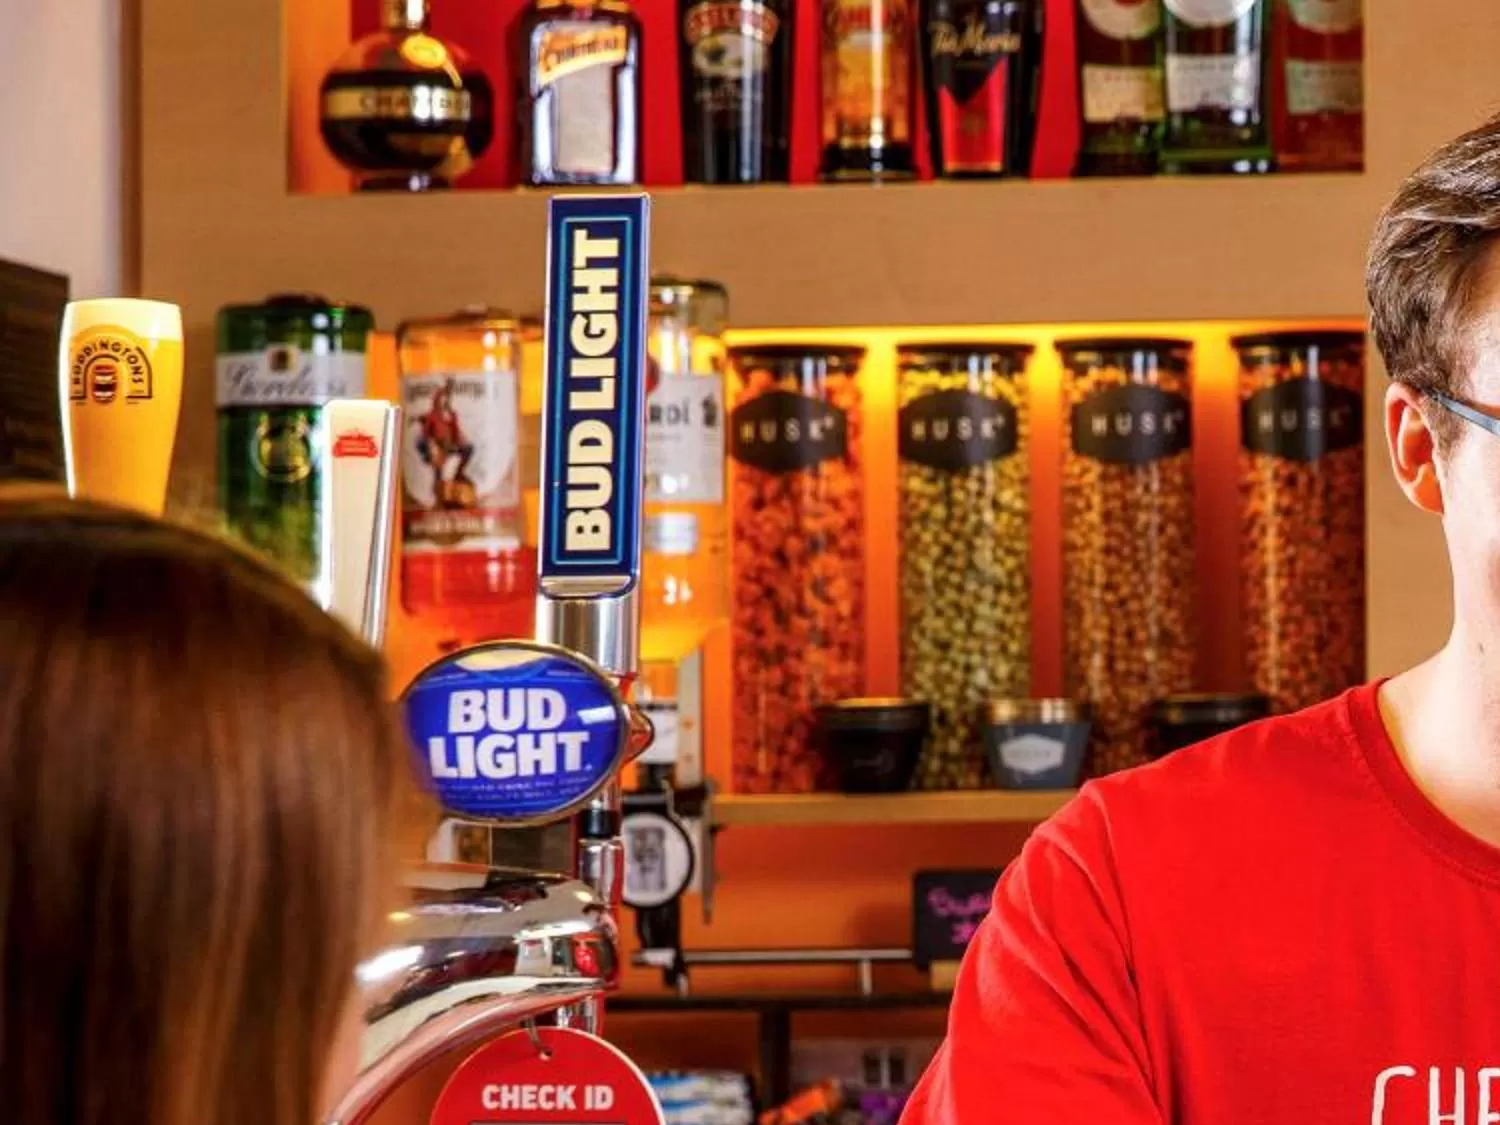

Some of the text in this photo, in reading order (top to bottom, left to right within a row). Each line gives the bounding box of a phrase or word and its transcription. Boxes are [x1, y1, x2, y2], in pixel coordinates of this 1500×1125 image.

[566, 229, 619, 550] BUD LIGHT
[448, 688, 566, 733] BUD
[428, 732, 590, 779] LIGHT
[482, 1084, 614, 1110] CHECK ID
